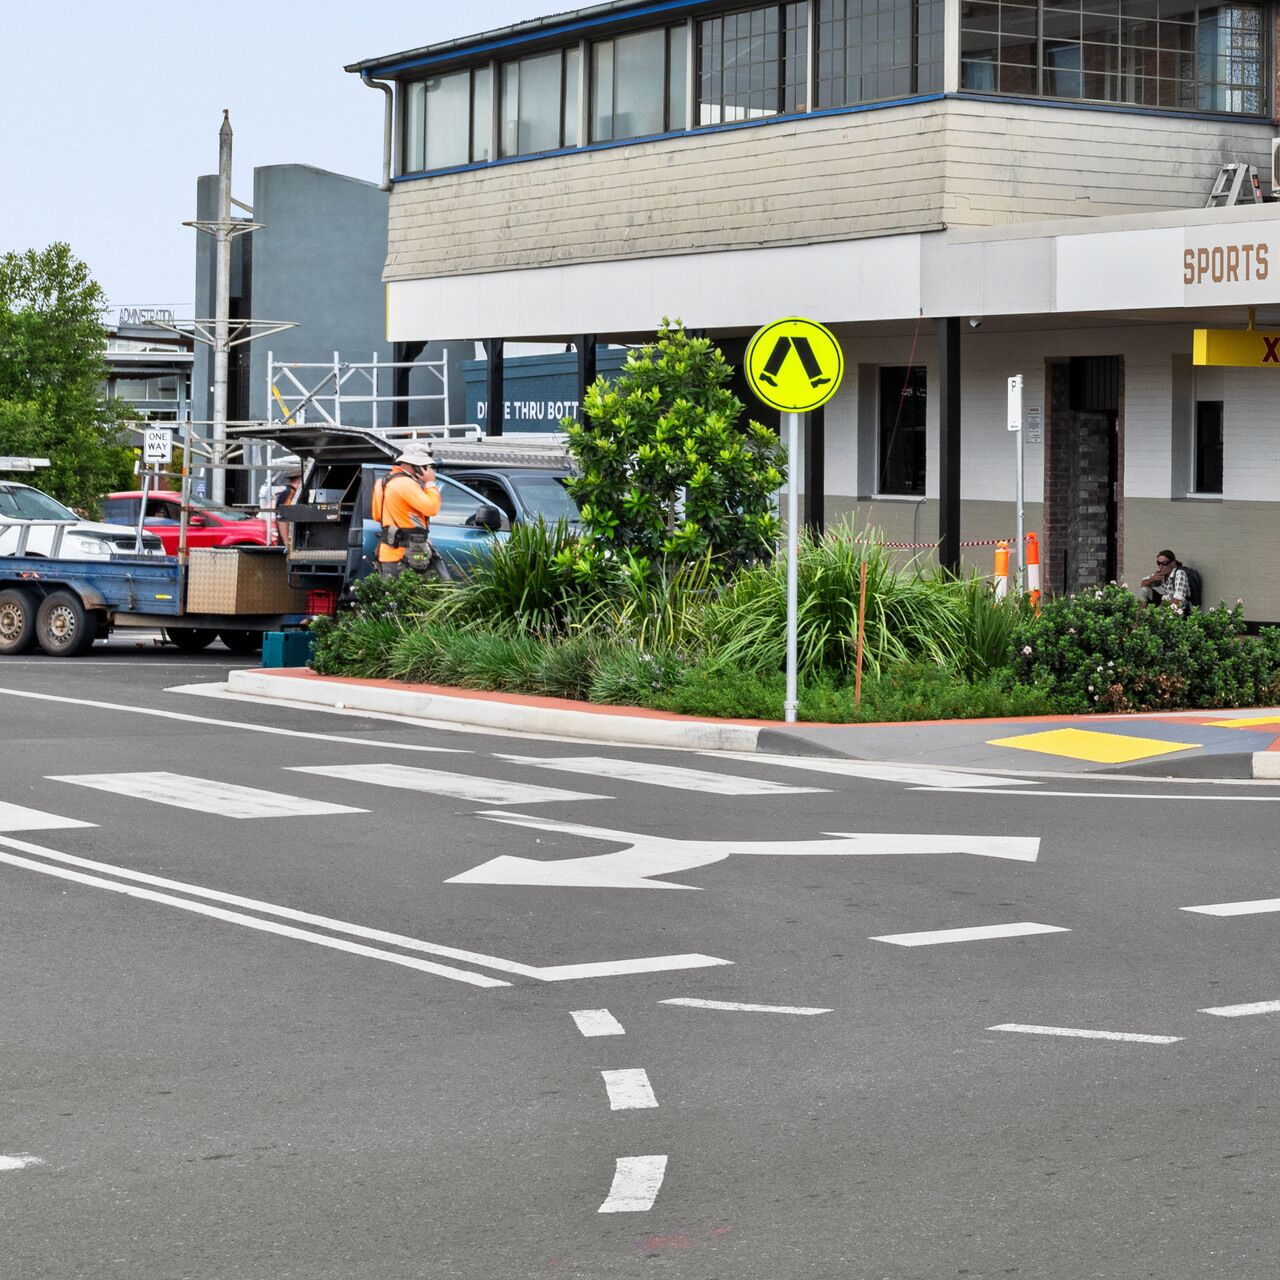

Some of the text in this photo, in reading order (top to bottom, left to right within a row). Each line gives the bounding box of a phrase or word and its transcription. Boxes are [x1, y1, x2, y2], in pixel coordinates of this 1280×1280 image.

[1183, 243, 1269, 284] SPORTS
[514, 402, 545, 420] THRU
[149, 432, 167, 441] ONE
[148, 442, 167, 451] WAY
